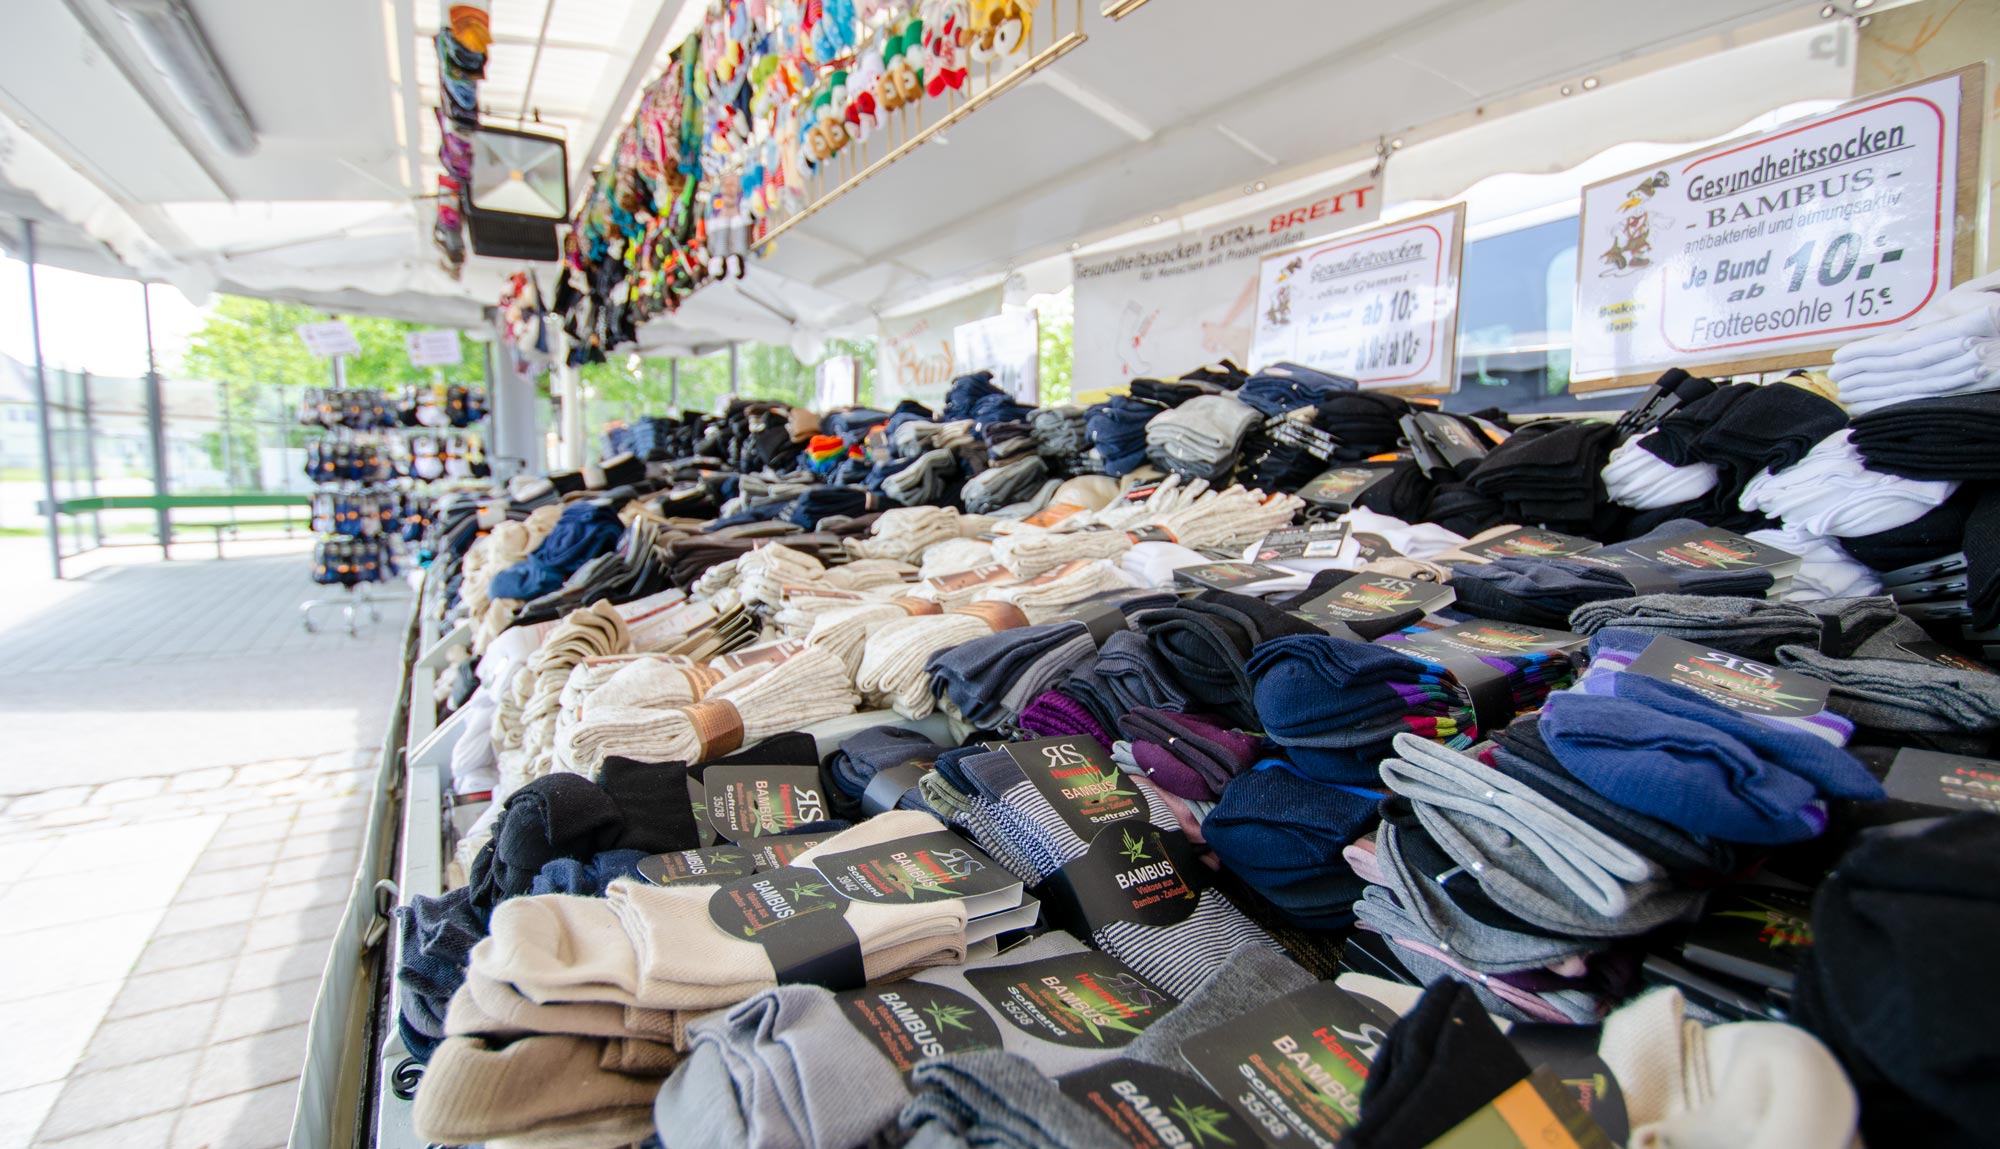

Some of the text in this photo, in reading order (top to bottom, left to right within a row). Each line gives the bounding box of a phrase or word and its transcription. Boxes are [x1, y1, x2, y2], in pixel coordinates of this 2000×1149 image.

[1687, 125, 1905, 201] Gesundheitssocken
[1706, 168, 1874, 229] BAMBUS
[1075, 241, 1203, 279] Gesundheitssocken
[1269, 186, 1375, 235] BREIT
[1684, 191, 1902, 254] antibakteriell und atmungsaktiv
[1354, 271, 1408, 295] Gummi
[1682, 265, 1707, 290] Je
[1713, 250, 1772, 285] Bund
[1362, 294, 1383, 326] ab
[1727, 282, 1765, 303] ab
[1691, 297, 1832, 343] Frotteesohle
[1342, 591, 1393, 607] BAMBUS
[1457, 631, 1524, 647] BAMBUS
[1673, 662, 1777, 699] BAMBUS
[713, 797, 725, 818] 35/38
[726, 784, 739, 831] Softrand
[755, 780, 774, 830] BAMBUS
[1061, 780, 1117, 800] BAMBUS
[1090, 807, 1140, 823] Softrand
[763, 846, 780, 869] Softran
[890, 852, 939, 889] BAMBUS
[1115, 860, 1174, 889] BAMBUS
[752, 880, 796, 919] BAMBUS
[846, 865, 884, 898] Softrand
[1132, 894, 1160, 909] Bambus
[1001, 1000, 1034, 1026] 35/38
[1008, 986, 1067, 1037] Softrand
[1041, 975, 1111, 1026] BAMBUS
[1075, 973, 1138, 1019] Harmony
[878, 992, 944, 1058] BAMBUS
[1312, 1027, 1370, 1078] Harm
[1249, 1053, 1293, 1097] Bambus
[1272, 1035, 1361, 1120] BAMBU
[1238, 1063, 1337, 1149] Softrand
[1239, 1091, 1290, 1140] 35/38
